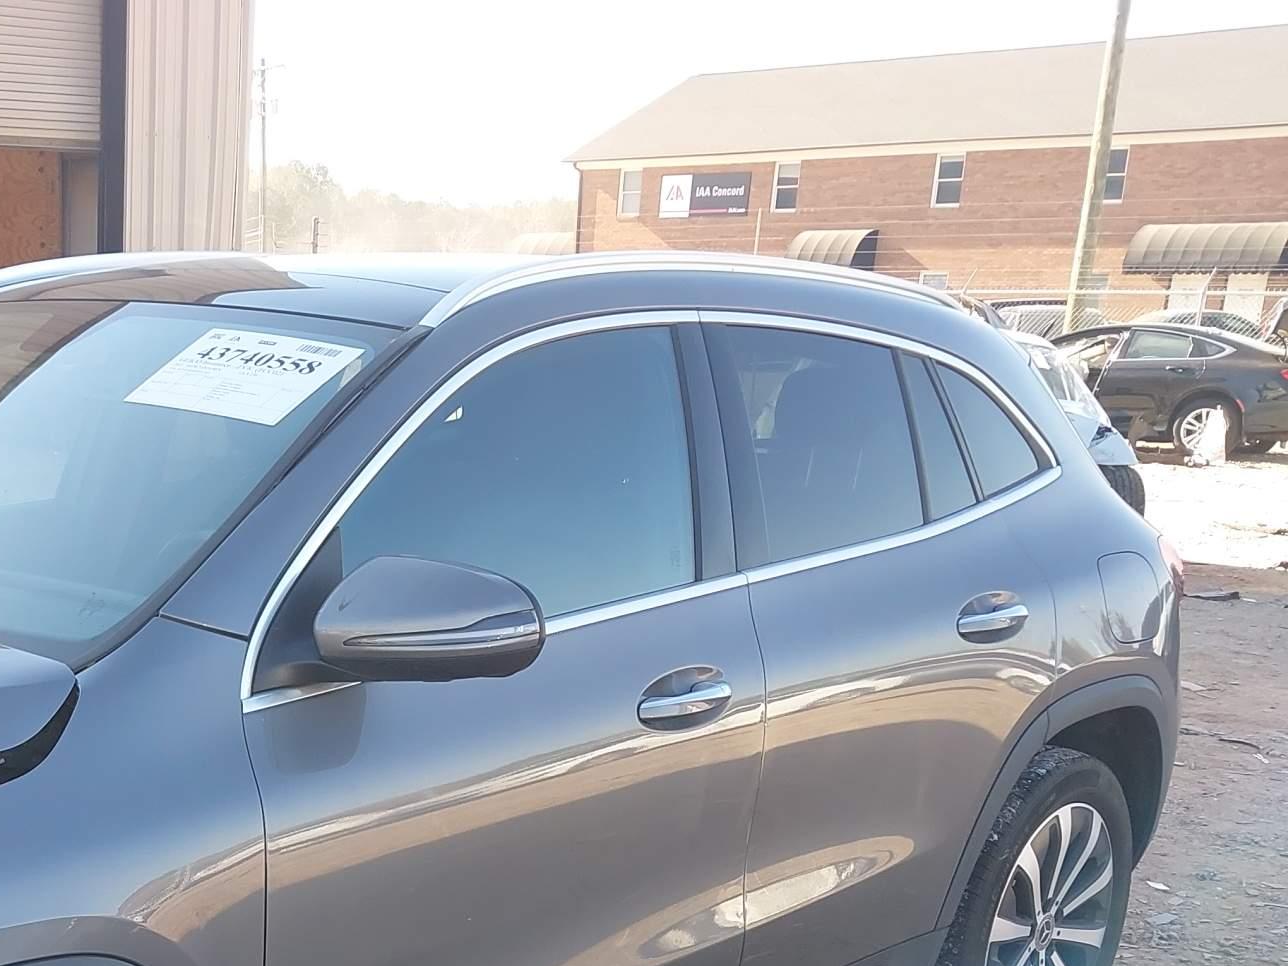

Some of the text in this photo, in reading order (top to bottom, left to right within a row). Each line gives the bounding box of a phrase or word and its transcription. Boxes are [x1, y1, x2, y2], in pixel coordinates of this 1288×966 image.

[695, 185, 745, 197] IAA Concord
[197, 346, 322, 376] 43740558
